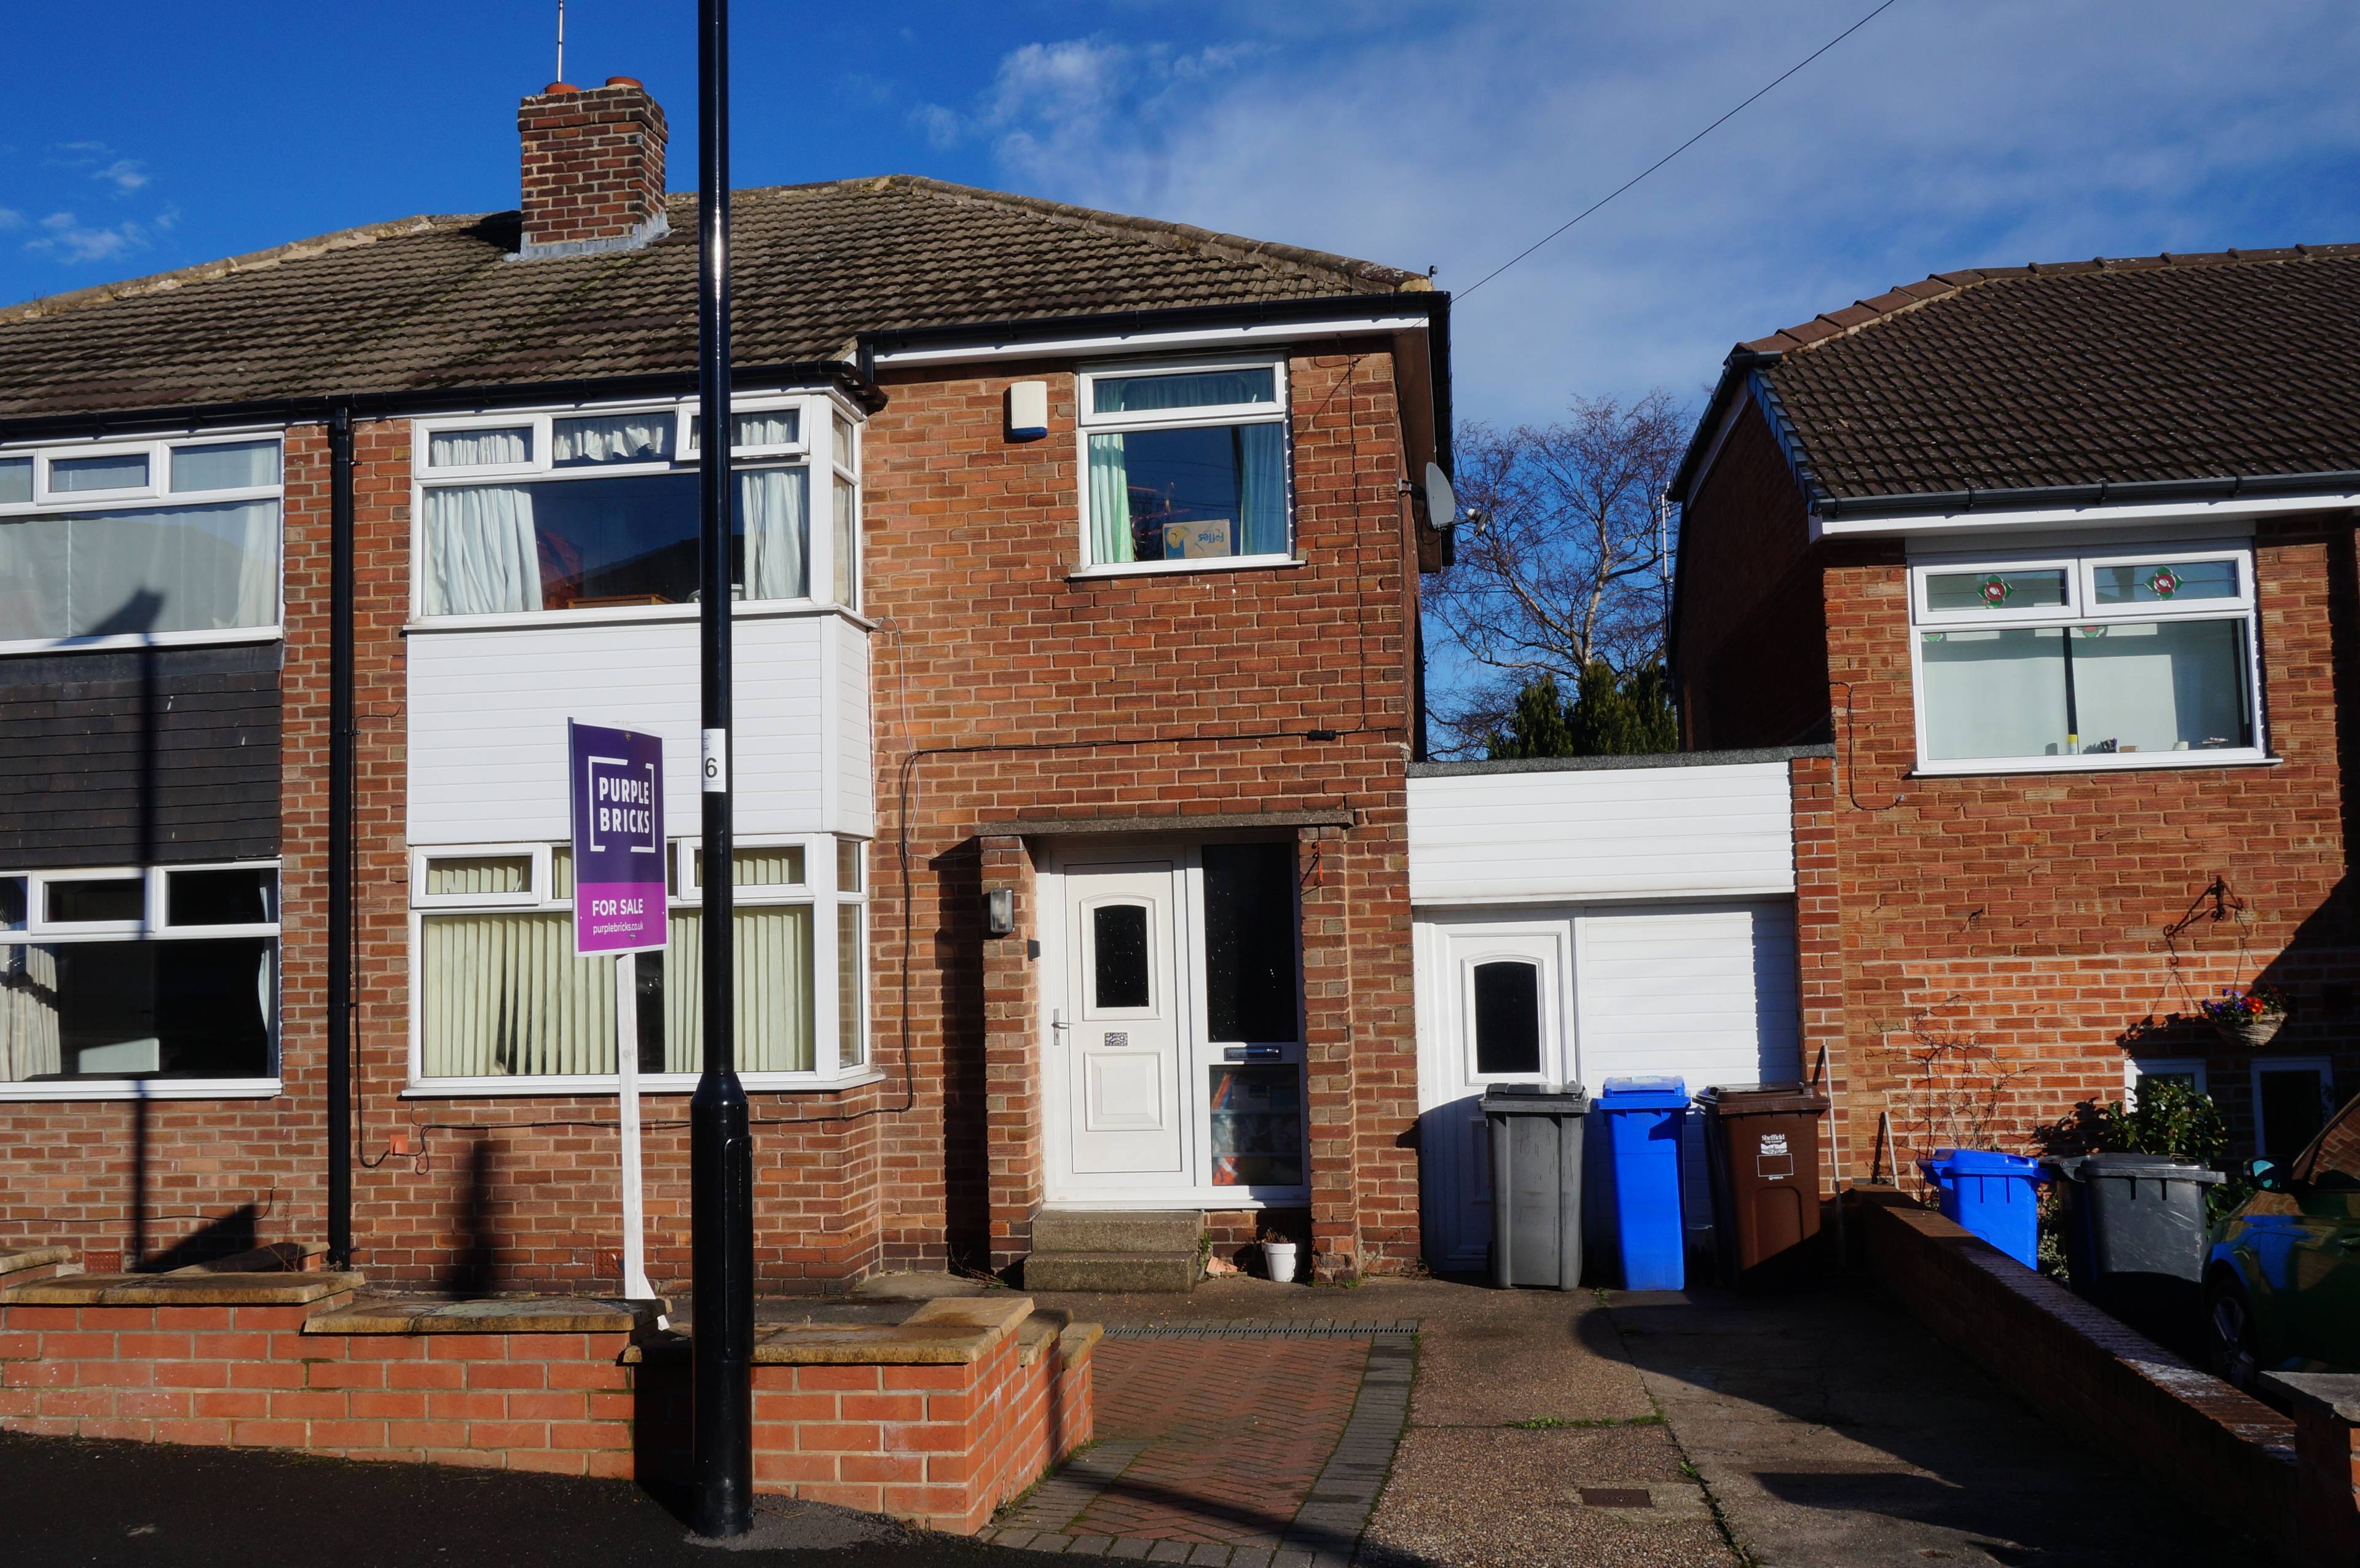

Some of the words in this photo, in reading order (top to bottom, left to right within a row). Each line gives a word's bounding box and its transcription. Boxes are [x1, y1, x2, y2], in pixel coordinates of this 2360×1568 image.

[705, 757, 718, 778] 6
[599, 777, 649, 804] PURPLE
[600, 807, 650, 834] BRICKS
[592, 900, 617, 917] FOR
[620, 898, 643, 915] SALE
[592, 920, 644, 936] purplebricks.co.uk
